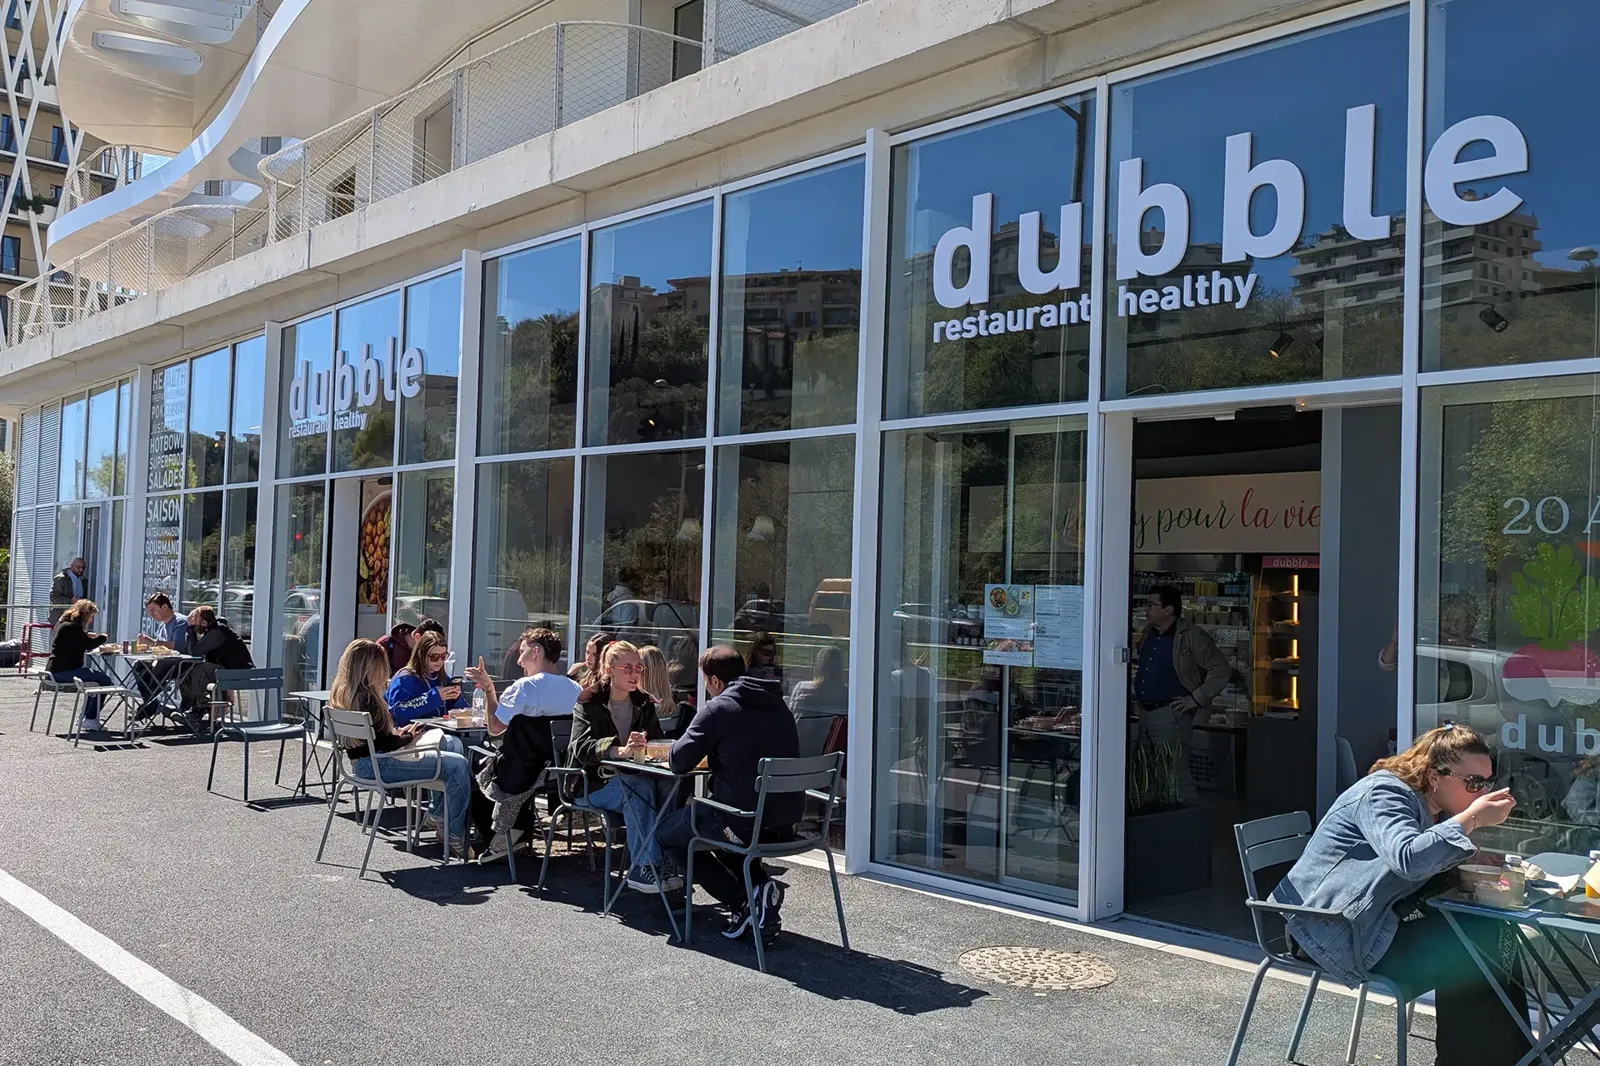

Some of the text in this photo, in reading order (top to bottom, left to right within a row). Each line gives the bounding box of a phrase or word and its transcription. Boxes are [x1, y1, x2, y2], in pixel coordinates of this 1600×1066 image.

[932, 103, 1530, 309] dubble
[932, 270, 1258, 343] restaurant healthy
[289, 336, 424, 420] dubble
[334, 411, 368, 430] healthy
[148, 469, 183, 489] SALADES
[147, 499, 181, 522] SAISON
[1156, 500, 1236, 545] pour
[1240, 488, 1278, 530] la
[1284, 499, 1321, 530] vie
[1502, 496, 1570, 535] 20
[1273, 558, 1309, 567] dubble
[1501, 713, 1600, 756] dub
